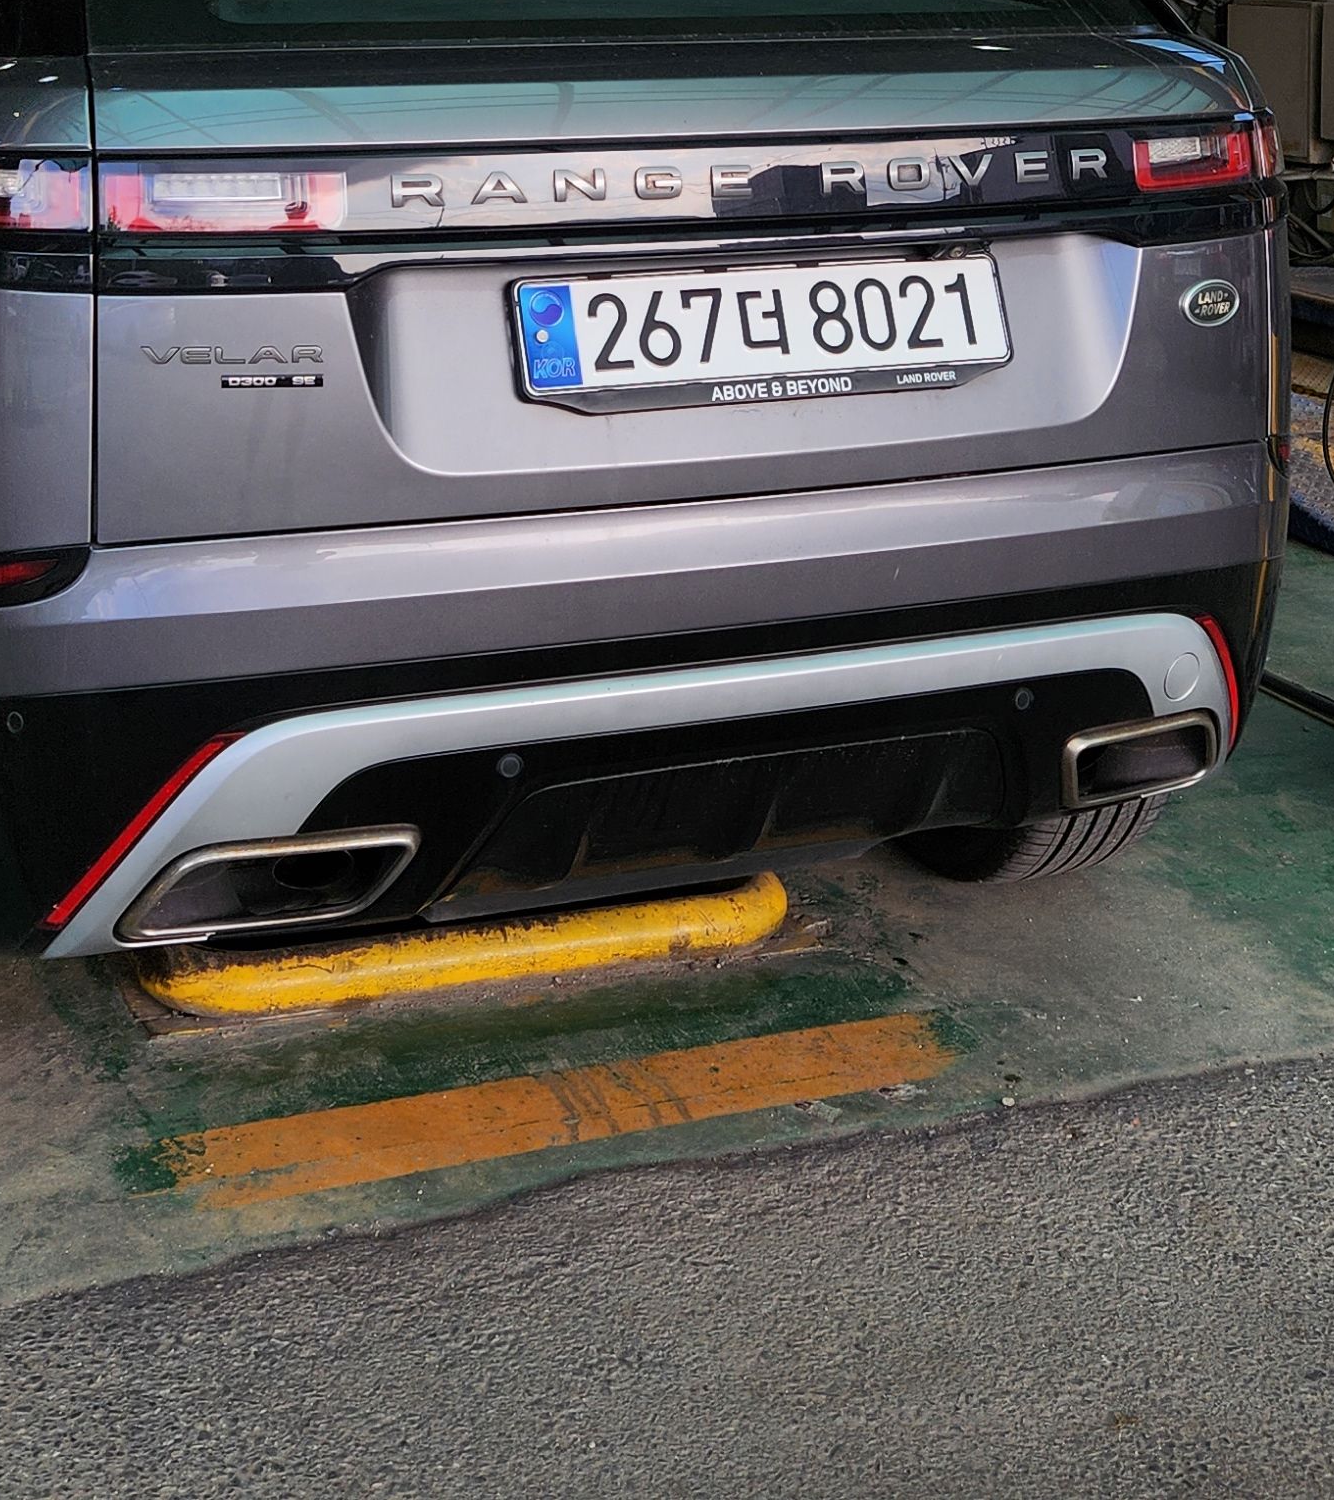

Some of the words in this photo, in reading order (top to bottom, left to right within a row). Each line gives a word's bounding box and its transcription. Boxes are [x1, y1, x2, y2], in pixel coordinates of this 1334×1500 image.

[390, 162, 755, 208] RANGE
[820, 146, 1109, 195] ROVER
[1197, 290, 1224, 305] LAND
[1200, 301, 1231, 316] ROVER
[587, 286, 791, 372] 267더
[807, 272, 979, 356] 8021
[140, 344, 324, 365] VELAR
[532, 355, 576, 380] KOR
[896, 373, 923, 385] LAND
[924, 370, 957, 384] ROVER
[228, 376, 278, 387] D300
[291, 375, 317, 386] SE
[711, 381, 769, 402] ABOVE
[771, 381, 783, 397] &
[786, 376, 853, 396] BEYOND
